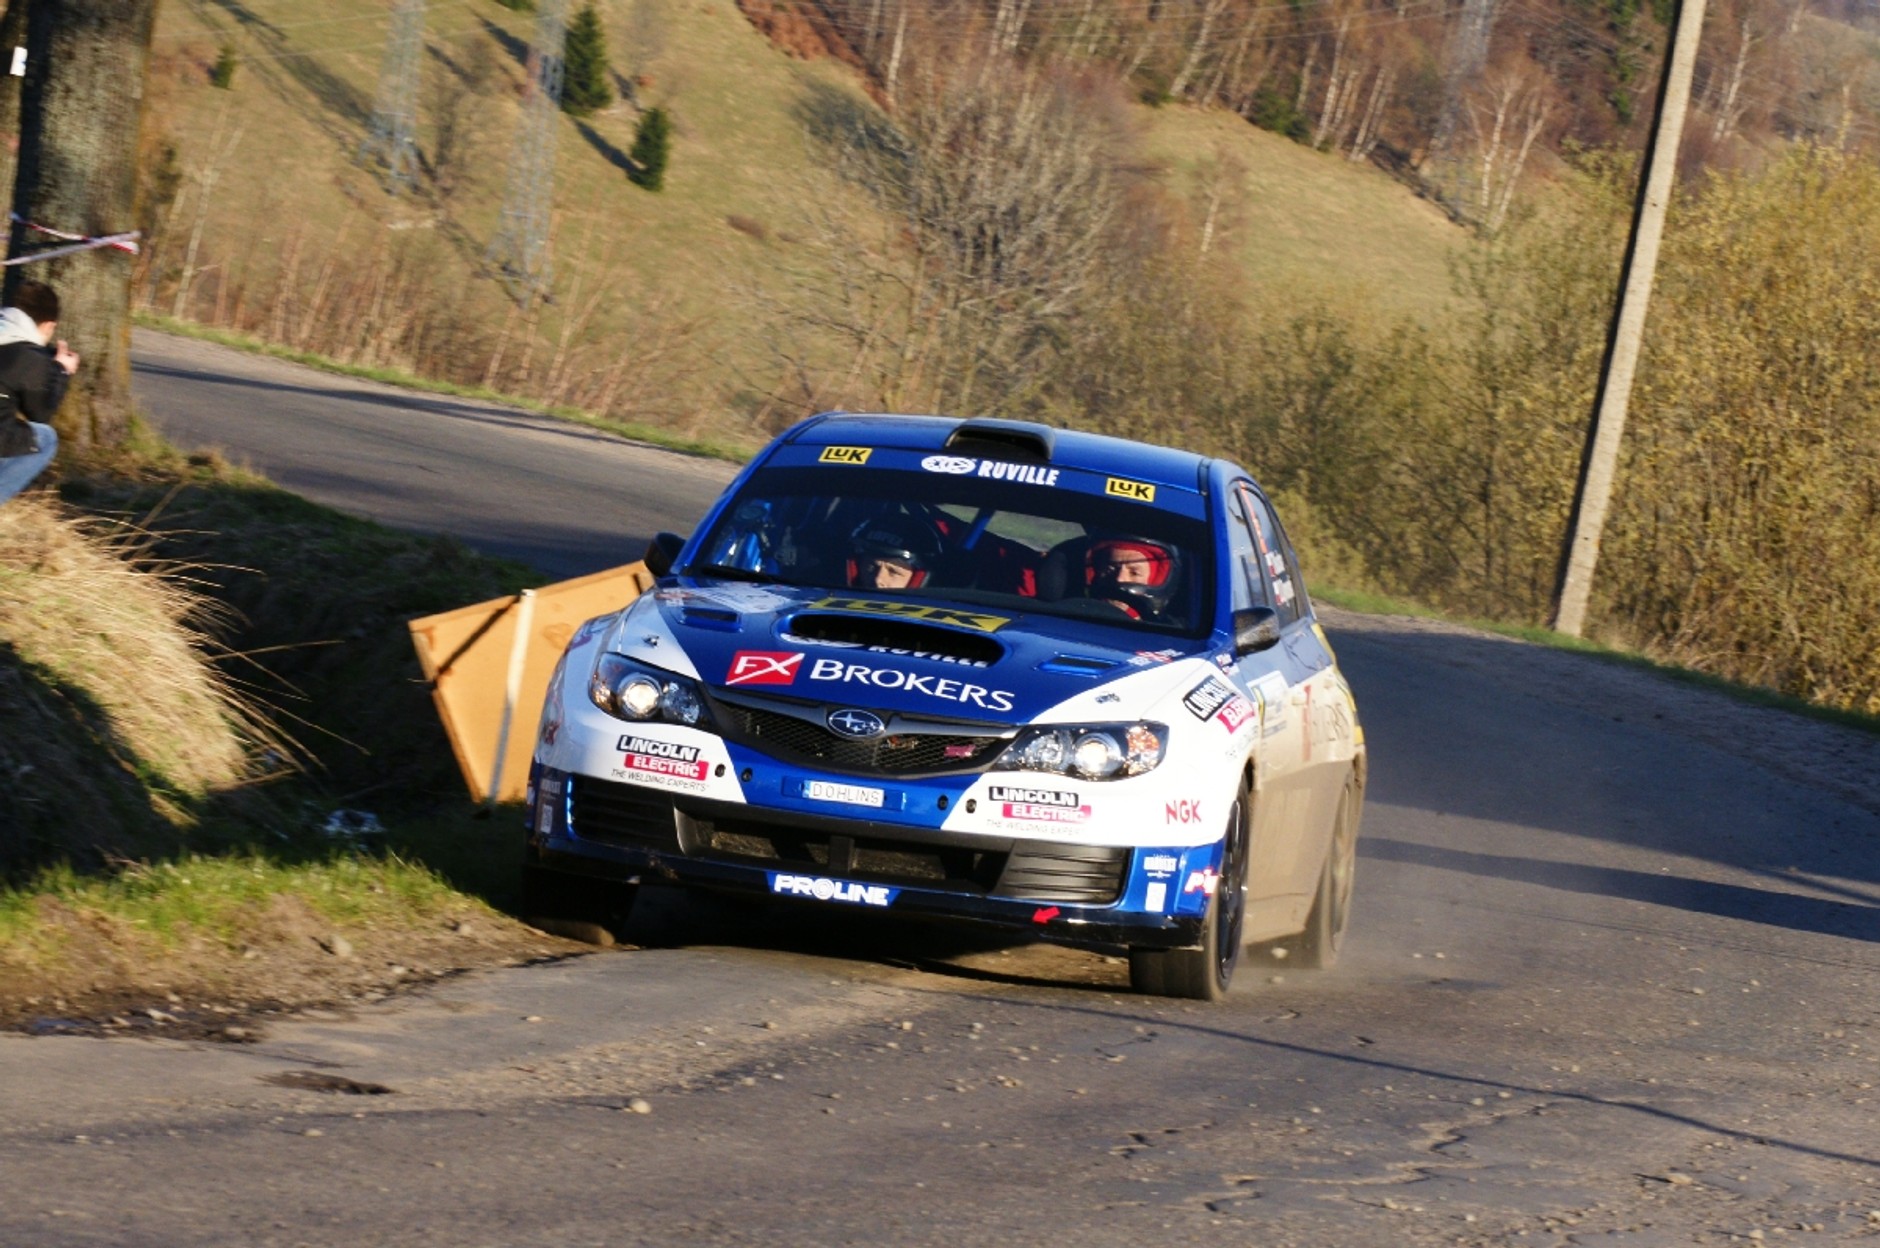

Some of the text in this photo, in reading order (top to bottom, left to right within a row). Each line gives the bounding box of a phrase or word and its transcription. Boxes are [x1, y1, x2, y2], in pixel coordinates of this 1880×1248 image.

[977, 460, 1060, 486] RUVILLE
[727, 653, 1015, 712] FX BROKERS
[620, 736, 697, 762] LINCOLN
[611, 769, 625, 779] THE
[628, 771, 664, 784] WELDING
[632, 756, 700, 778] ELECTRIC
[992, 786, 1077, 807] LINCOLN
[1166, 799, 1202, 825] NGK
[774, 874, 890, 906] PROLINE
